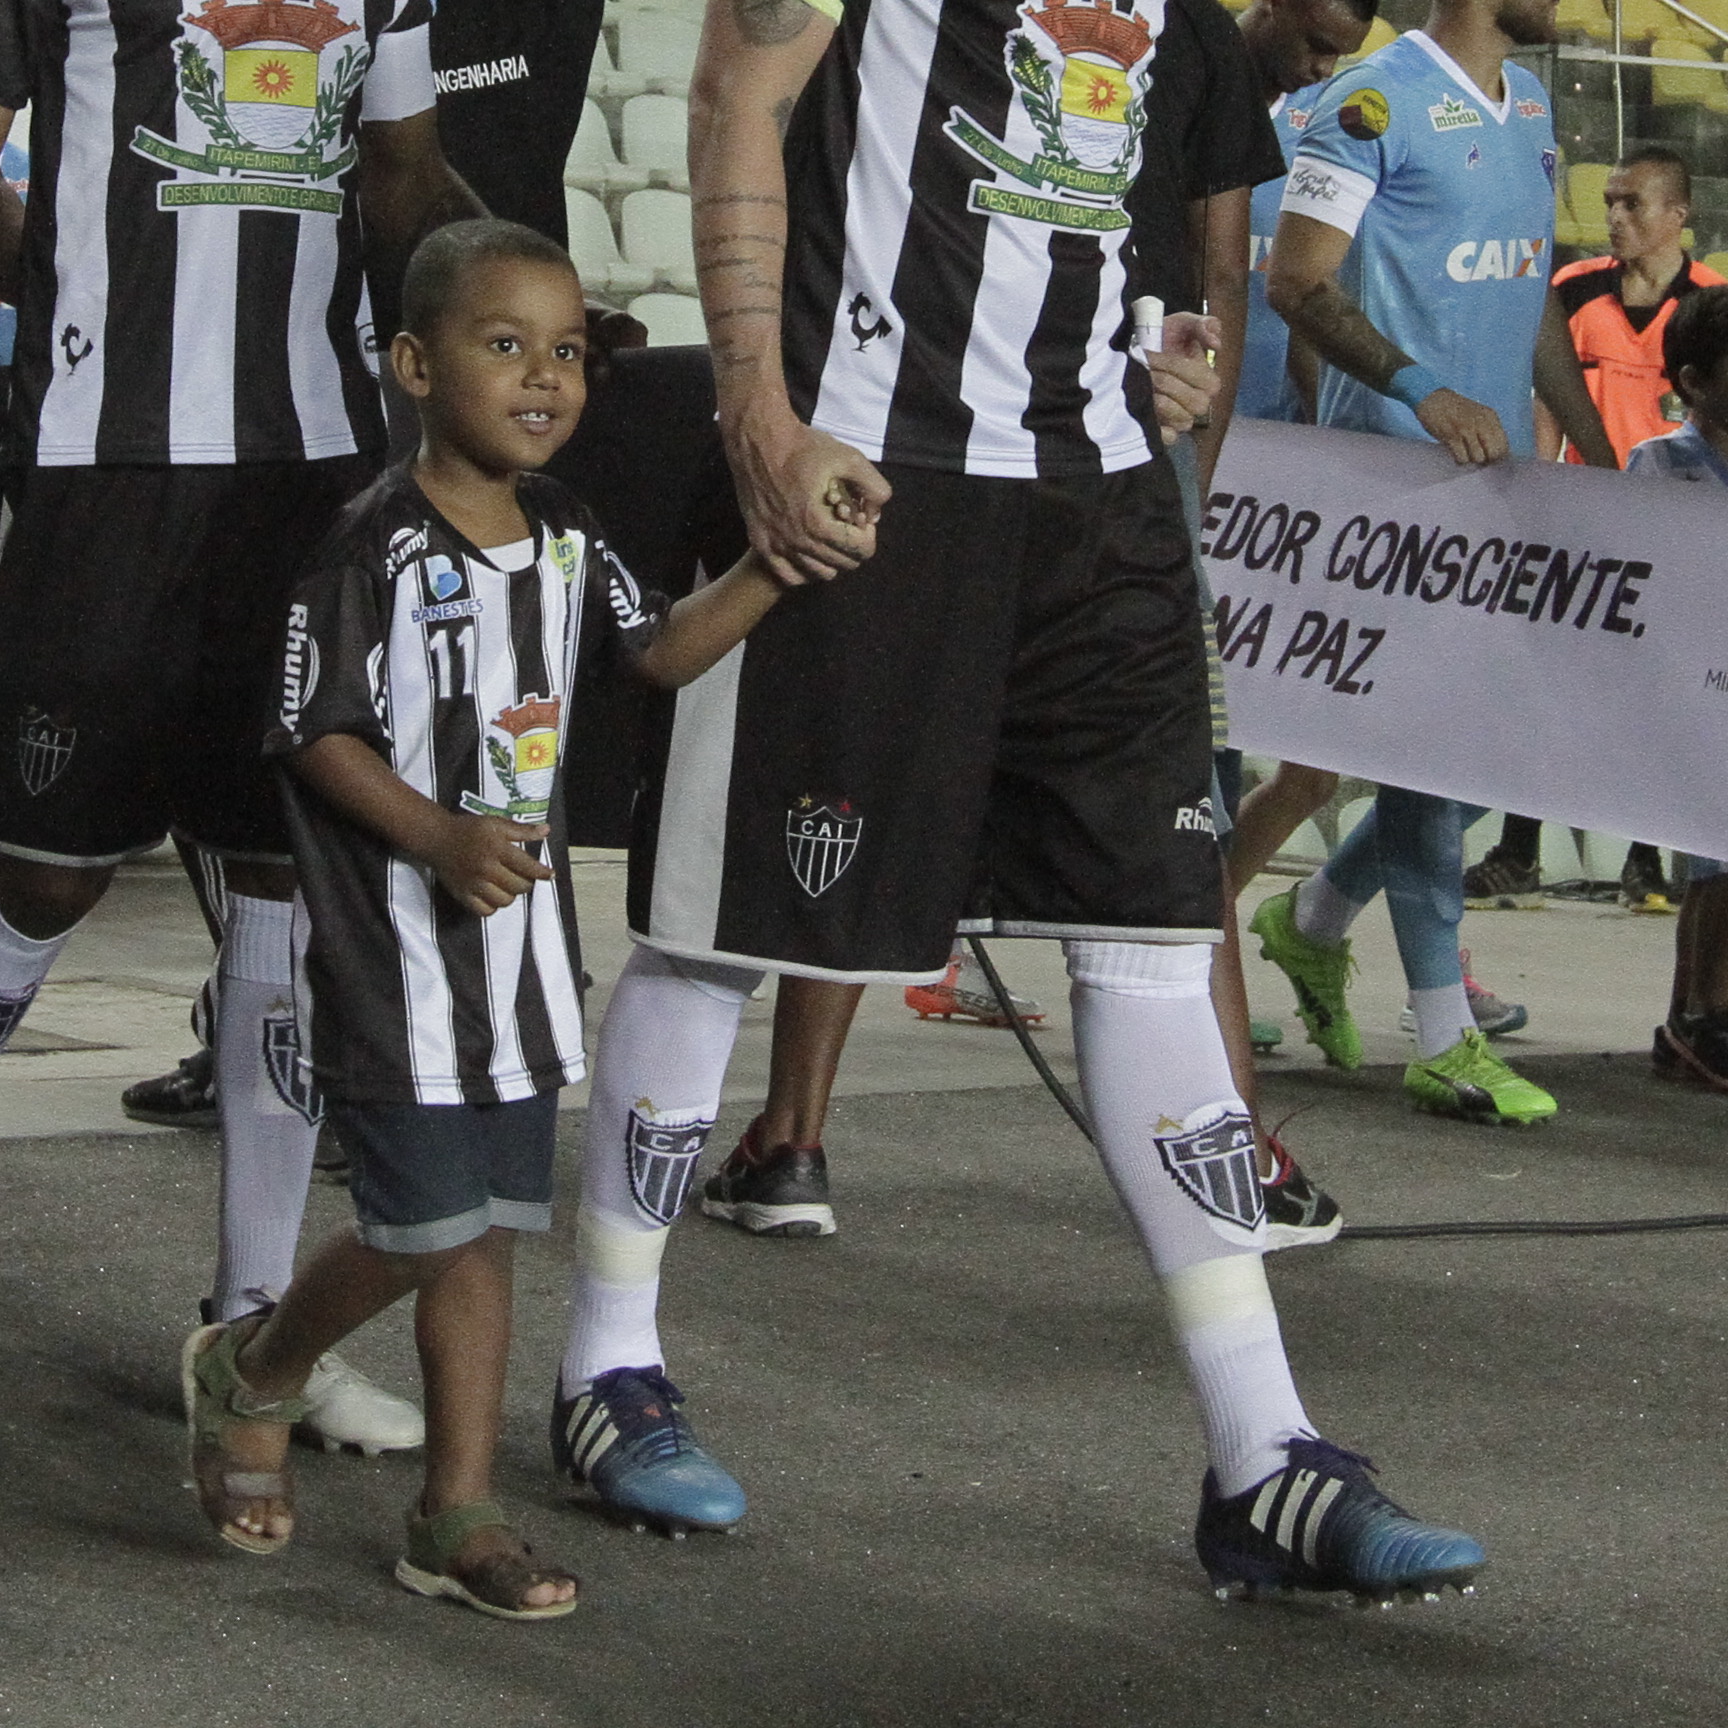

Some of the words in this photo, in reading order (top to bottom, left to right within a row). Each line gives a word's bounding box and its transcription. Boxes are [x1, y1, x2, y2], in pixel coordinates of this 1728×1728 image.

[1434, 110, 1478, 129] mirella
[209, 148, 296, 171] ITAPEMIRIM
[1034, 159, 1110, 190] ITAPEMIRIM
[165, 184, 288, 206] DESENVOLVIMENTO
[1327, 514, 1653, 639] CONSCIENTE.
[411, 598, 485, 623] BANESTES
[429, 624, 476, 699] 11
[1273, 610, 1386, 696] PAZ.
[280, 603, 309, 733] Rhumy
[800, 820, 843, 840] CAI
